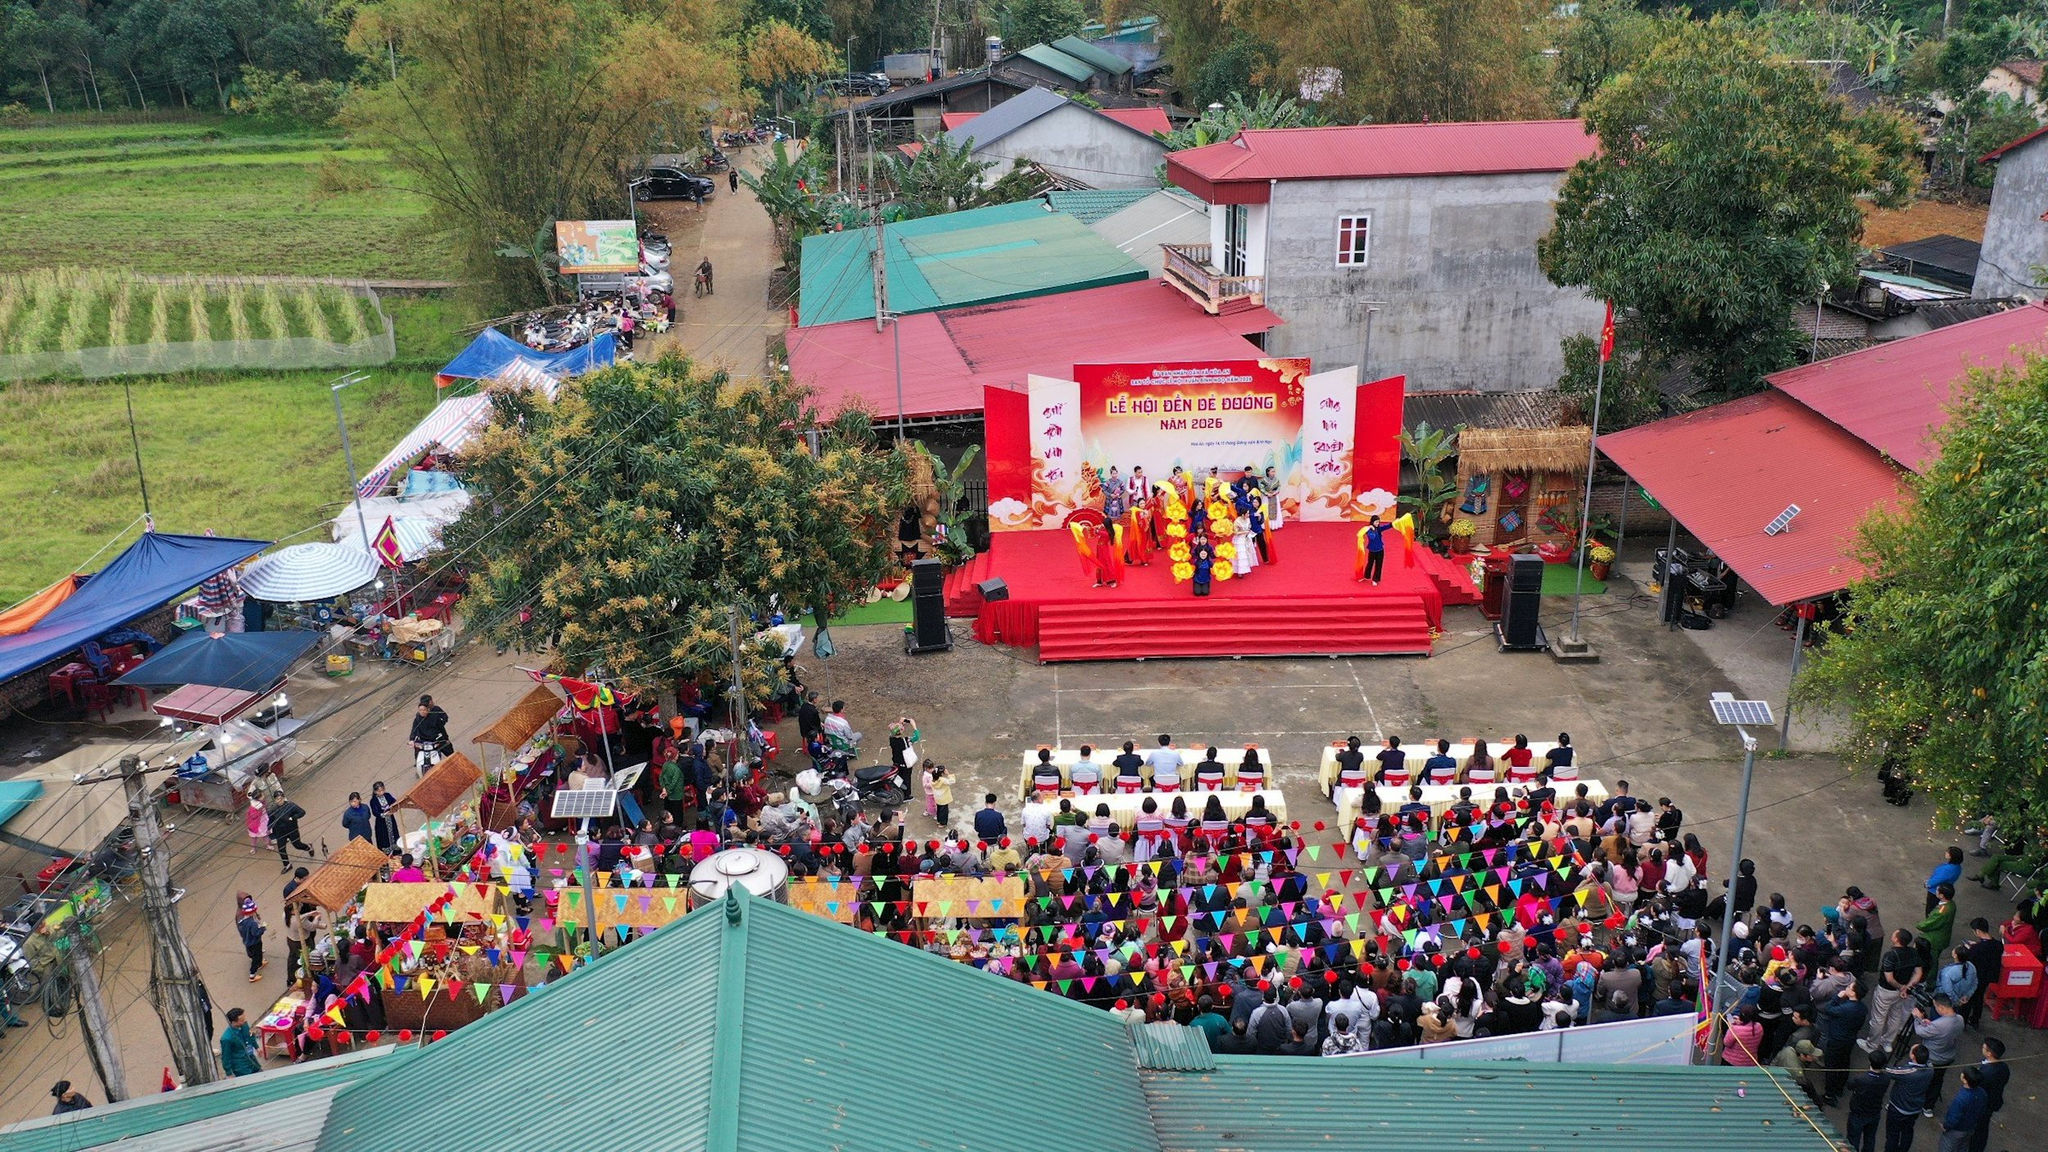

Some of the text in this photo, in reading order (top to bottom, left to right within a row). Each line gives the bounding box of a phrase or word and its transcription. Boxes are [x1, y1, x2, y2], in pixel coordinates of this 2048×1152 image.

[1110, 395, 1127, 413] LỄ
[1132, 397, 1158, 416] HỘI
[1163, 394, 1192, 412] ĐỀN
[1222, 394, 1273, 410] ĐOÓNG
[1160, 417, 1223, 430] NĂM 2026
